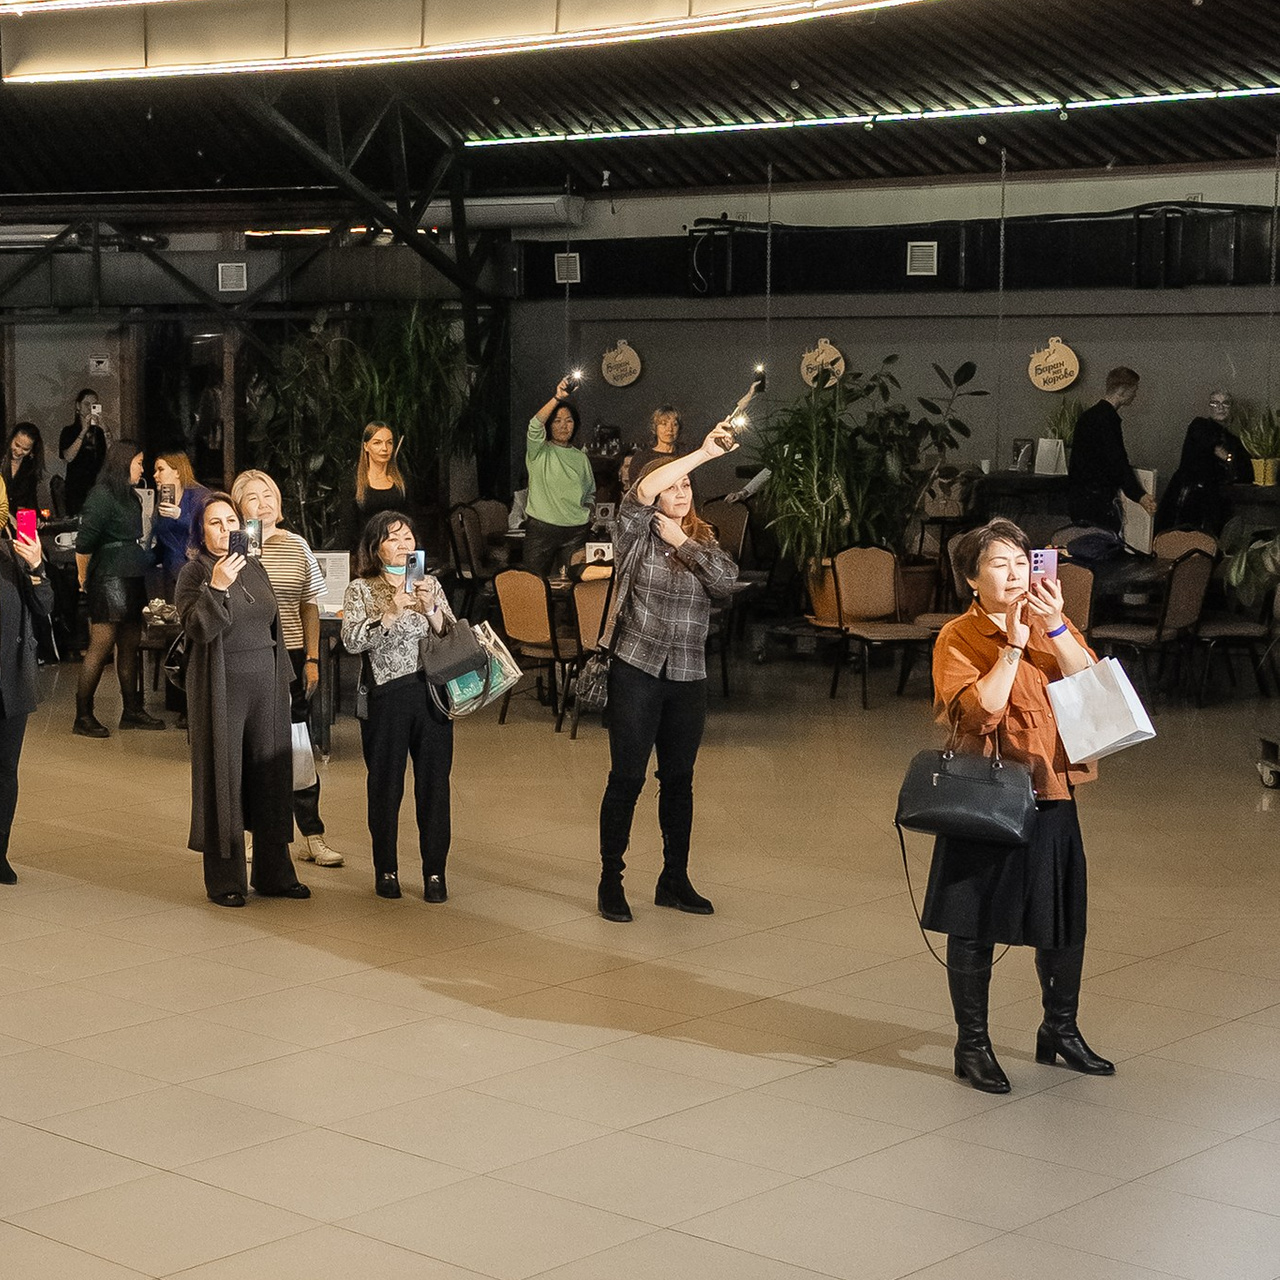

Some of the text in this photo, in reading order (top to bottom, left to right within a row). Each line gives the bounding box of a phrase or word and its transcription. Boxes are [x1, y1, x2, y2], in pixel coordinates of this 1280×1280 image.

[1034, 361, 1065, 377] Барин
[1042, 367, 1075, 387] Корове
[1052, 368, 1062, 376] на
